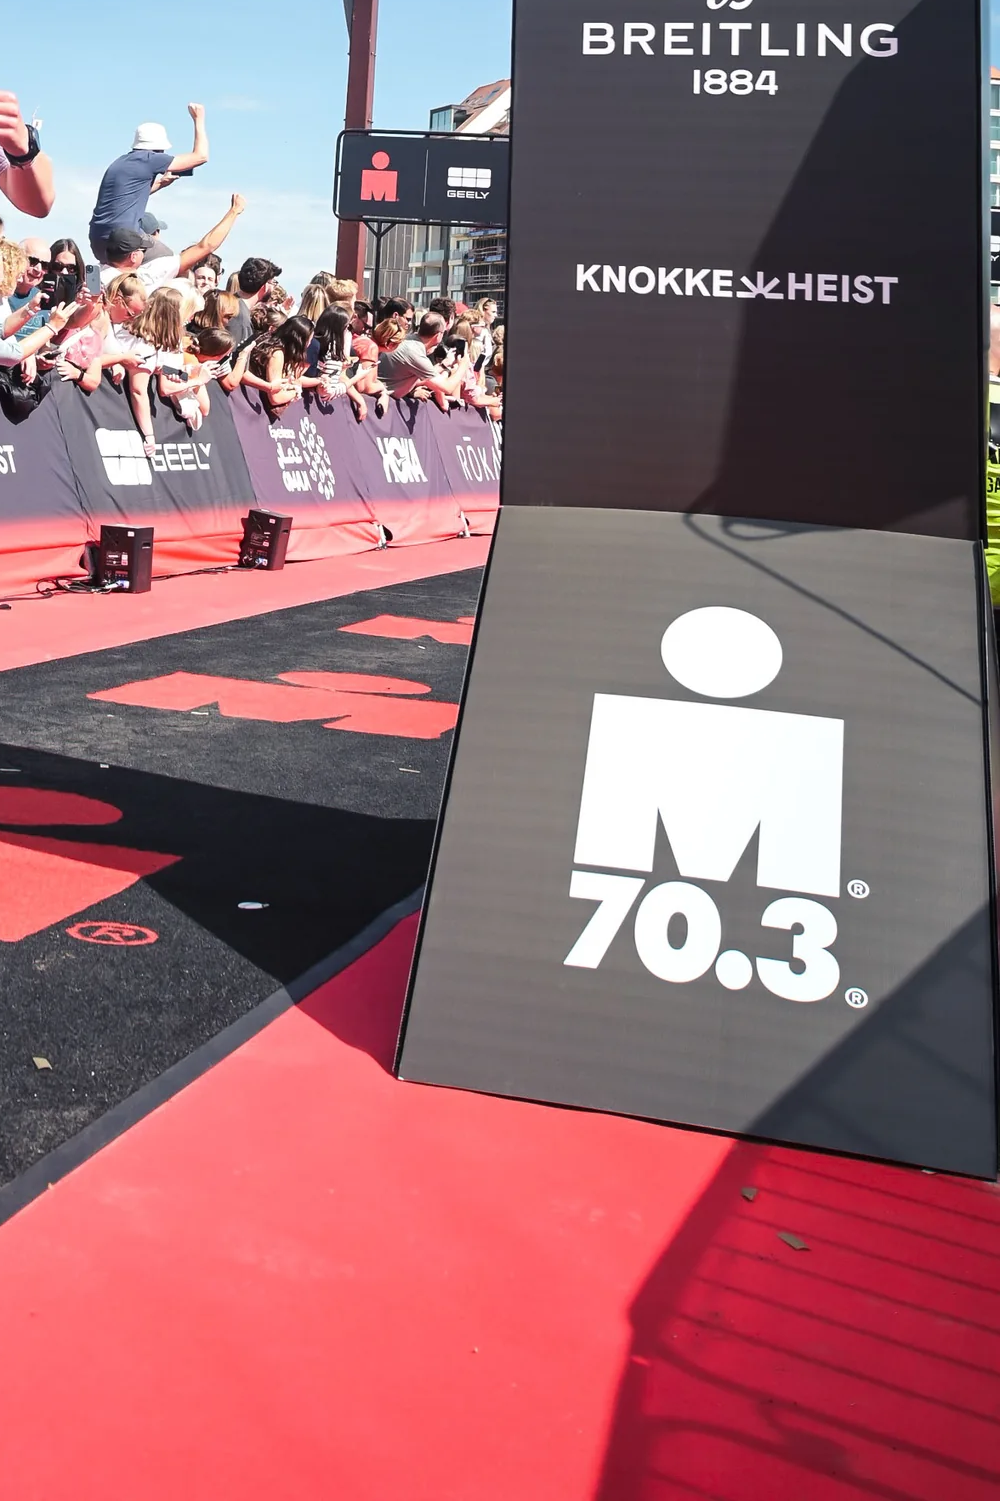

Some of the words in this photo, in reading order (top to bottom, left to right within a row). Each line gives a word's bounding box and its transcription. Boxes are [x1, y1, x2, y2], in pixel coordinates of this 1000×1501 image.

[582, 22, 899, 58] BREITLING
[693, 69, 779, 96] 1884
[447, 189, 490, 199] GEELY
[576, 264, 734, 298] KNOKKE
[788, 272, 898, 305] HEIST
[151, 443, 211, 471] GEELY
[376, 437, 428, 484] HOKA
[563, 870, 841, 1003] 70.3
